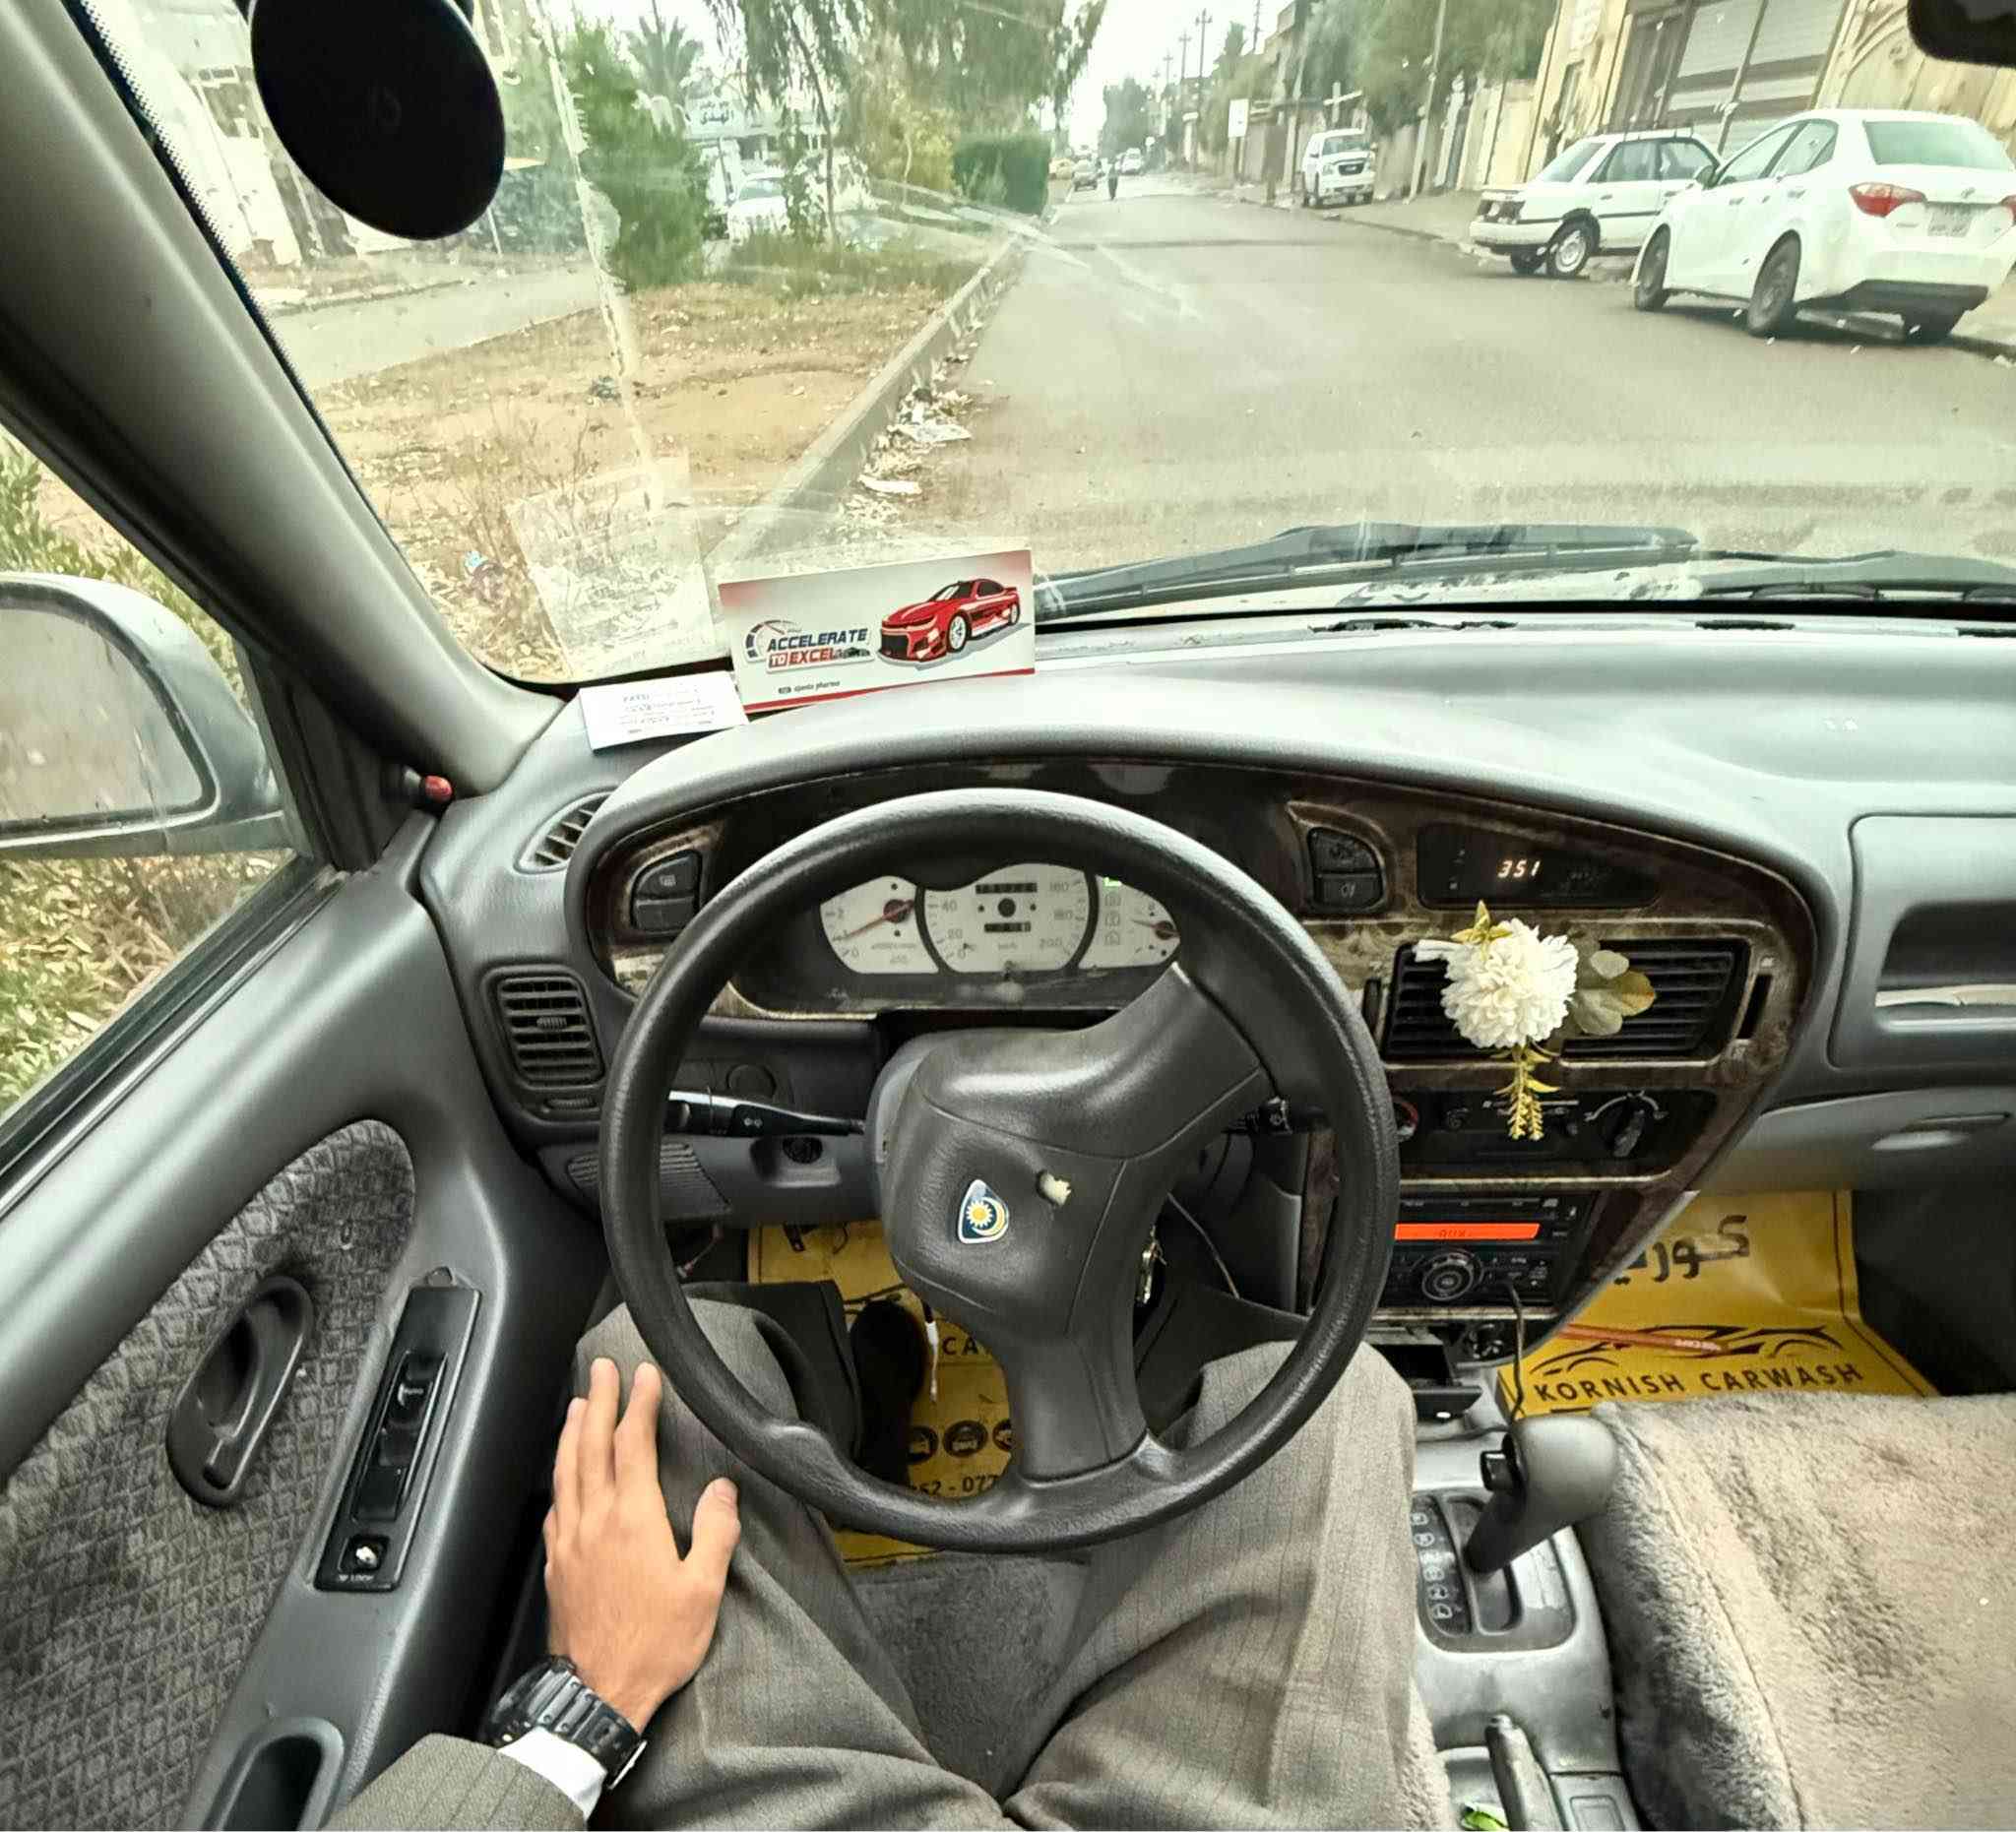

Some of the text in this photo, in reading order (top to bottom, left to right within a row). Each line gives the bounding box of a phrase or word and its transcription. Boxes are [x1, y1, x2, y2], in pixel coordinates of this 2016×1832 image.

[767, 628, 868, 652] ACCELERATE
[770, 647, 836, 667] TO EXCEL
[1533, 1362, 1864, 1402] KORNISH CARWASH
